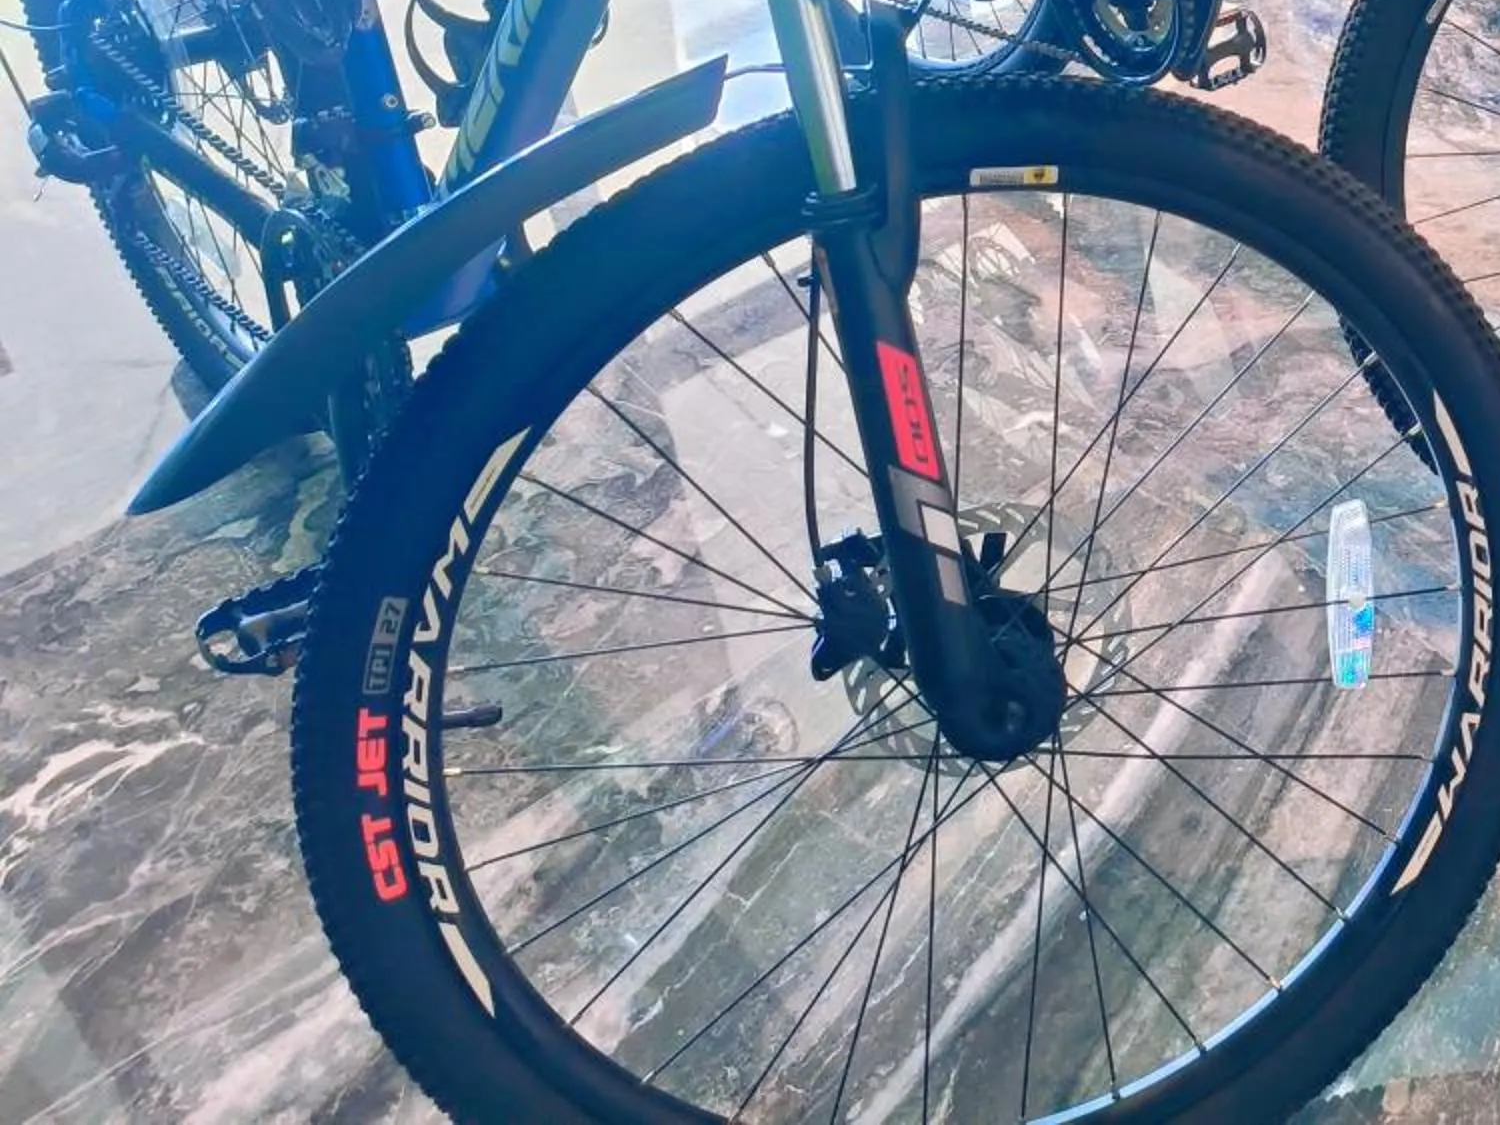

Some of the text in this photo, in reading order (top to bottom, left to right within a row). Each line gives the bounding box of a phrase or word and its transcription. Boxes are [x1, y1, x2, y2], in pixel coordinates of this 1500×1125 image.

[368, 600, 401, 690] TPI 27
[402, 514, 471, 915] WARRIOR
[1437, 481, 1494, 823] WARRIOR
[356, 707, 408, 902] CST JET
